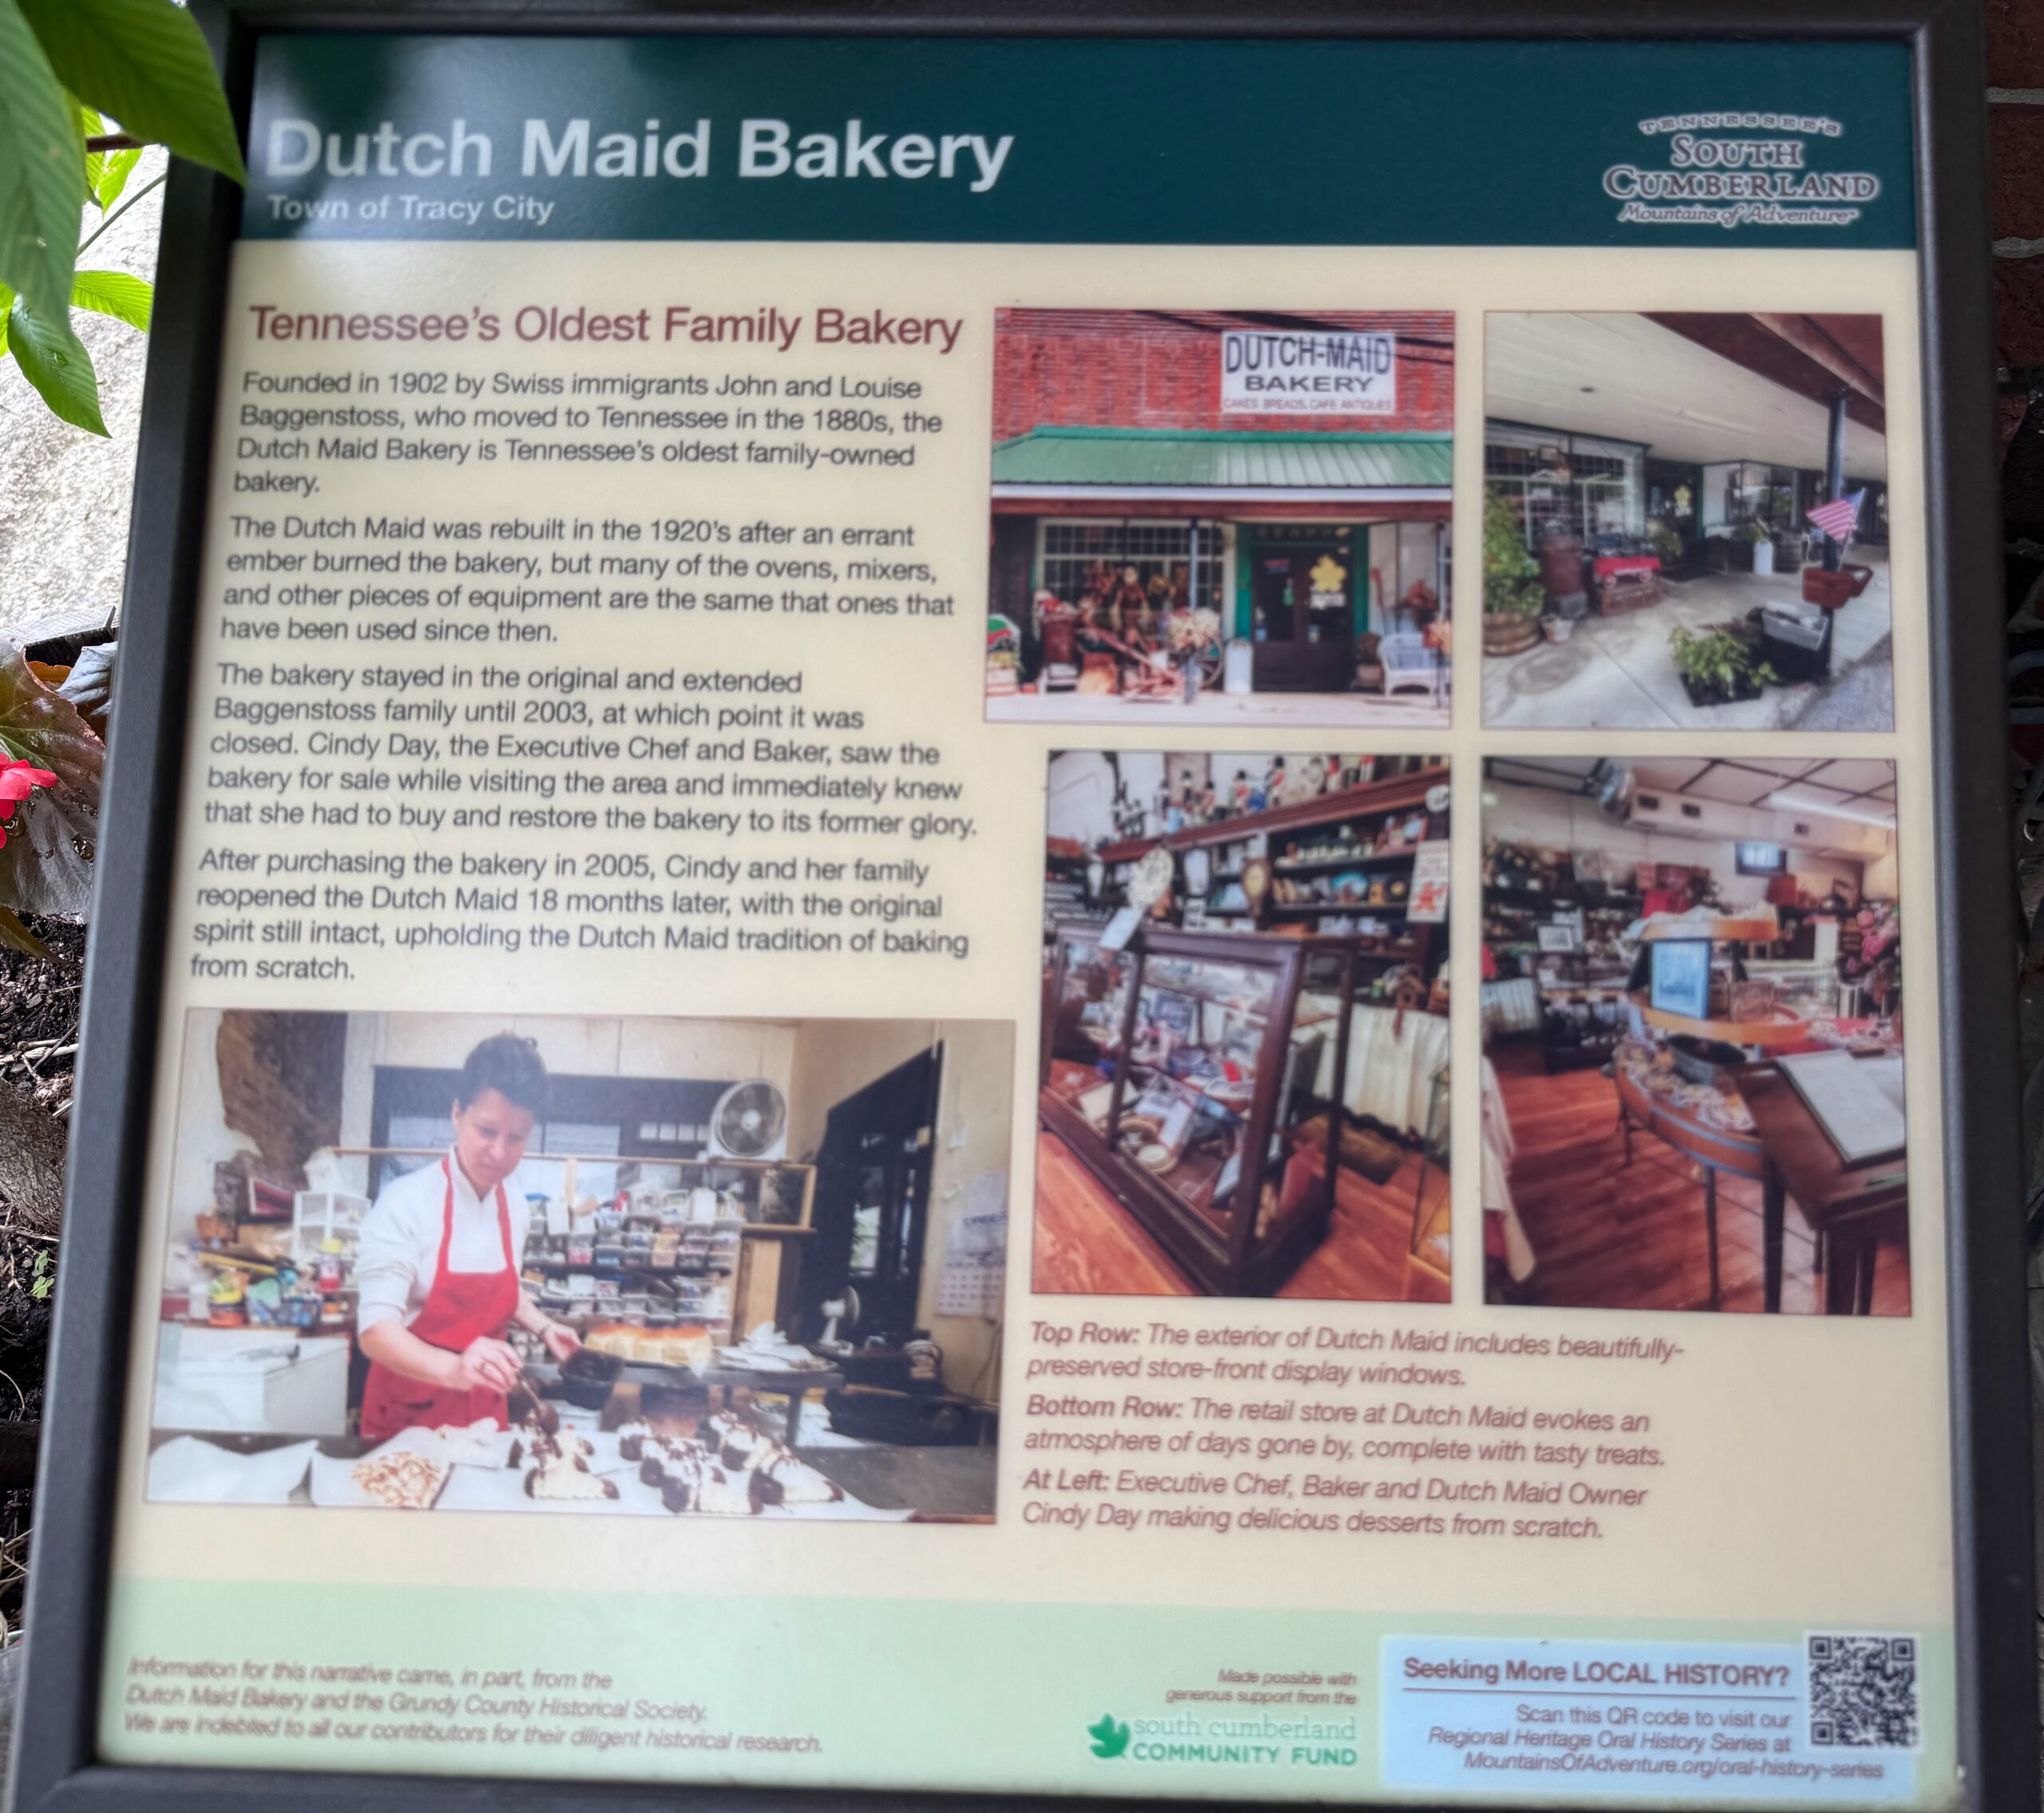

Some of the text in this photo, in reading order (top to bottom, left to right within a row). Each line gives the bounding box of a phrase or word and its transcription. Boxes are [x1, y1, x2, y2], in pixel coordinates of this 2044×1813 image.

[1641, 115, 1840, 135] TENNESSEE'S
[267, 118, 1015, 193] Dutch Maid Bakery
[1672, 136, 1802, 166] SOUTH
[1605, 167, 1876, 198] CUMBERLAND
[267, 193, 557, 227] Town of Tracy City
[1622, 204, 1717, 221] Mountains
[1720, 204, 1743, 226] of
[248, 304, 965, 355] Tennessee's Oldest Family Bakery
[1226, 334, 1391, 374] DUTCH-MAID
[243, 370, 923, 402] Founded in 1902 by Swiss immigrants John and Louise
[1245, 375, 1373, 392] BAKERY
[240, 403, 944, 437] Baggenstoss, who moved to Tennessee in the 1880s, the
[236, 437, 311, 460] Dutch
[316, 436, 379, 461] Maid
[385, 437, 472, 466] Bakery
[477, 437, 498, 461] is
[661, 439, 740, 464] oldest
[744, 440, 916, 470] family-owned
[233, 469, 320, 499] bakery.
[220, 616, 559, 643] have been used since then.
[216, 662, 803, 695] The bakery stayed in the original and extended
[189, 953, 356, 980] from scratch.
[1030, 1320, 1685, 1365] Top Row: The exterior of Dutch Maid includes beautifully-
[1024, 1355, 1467, 1389] preserved store-front display windows.
[1024, 1393, 1651, 1434] Bottom Row: The retail store at Dutch Maid evokes an
[1023, 1427, 1666, 1471] atmosphere of days gone by, complete with tasty treats.
[1020, 1467, 1650, 1506] At Left: Executive Chef, Baker and Dutch Maid Owner
[1021, 1500, 1604, 1539] Cindy Day making delicious desserts from scratch.
[1217, 1668, 1357, 1688] Made possible with
[1404, 1656, 1791, 1688] Seeking More LOCAL HISTORY?
[1165, 1688, 1359, 1706] generous support from the
[1133, 1711, 1357, 1740] south cumberland
[1515, 1703, 1792, 1730] Scan this QR code to visit our
[1132, 1743, 1357, 1766] COMMUNITY FUND
[1427, 1725, 1792, 1756] Regional Heritage Oral History Series at
